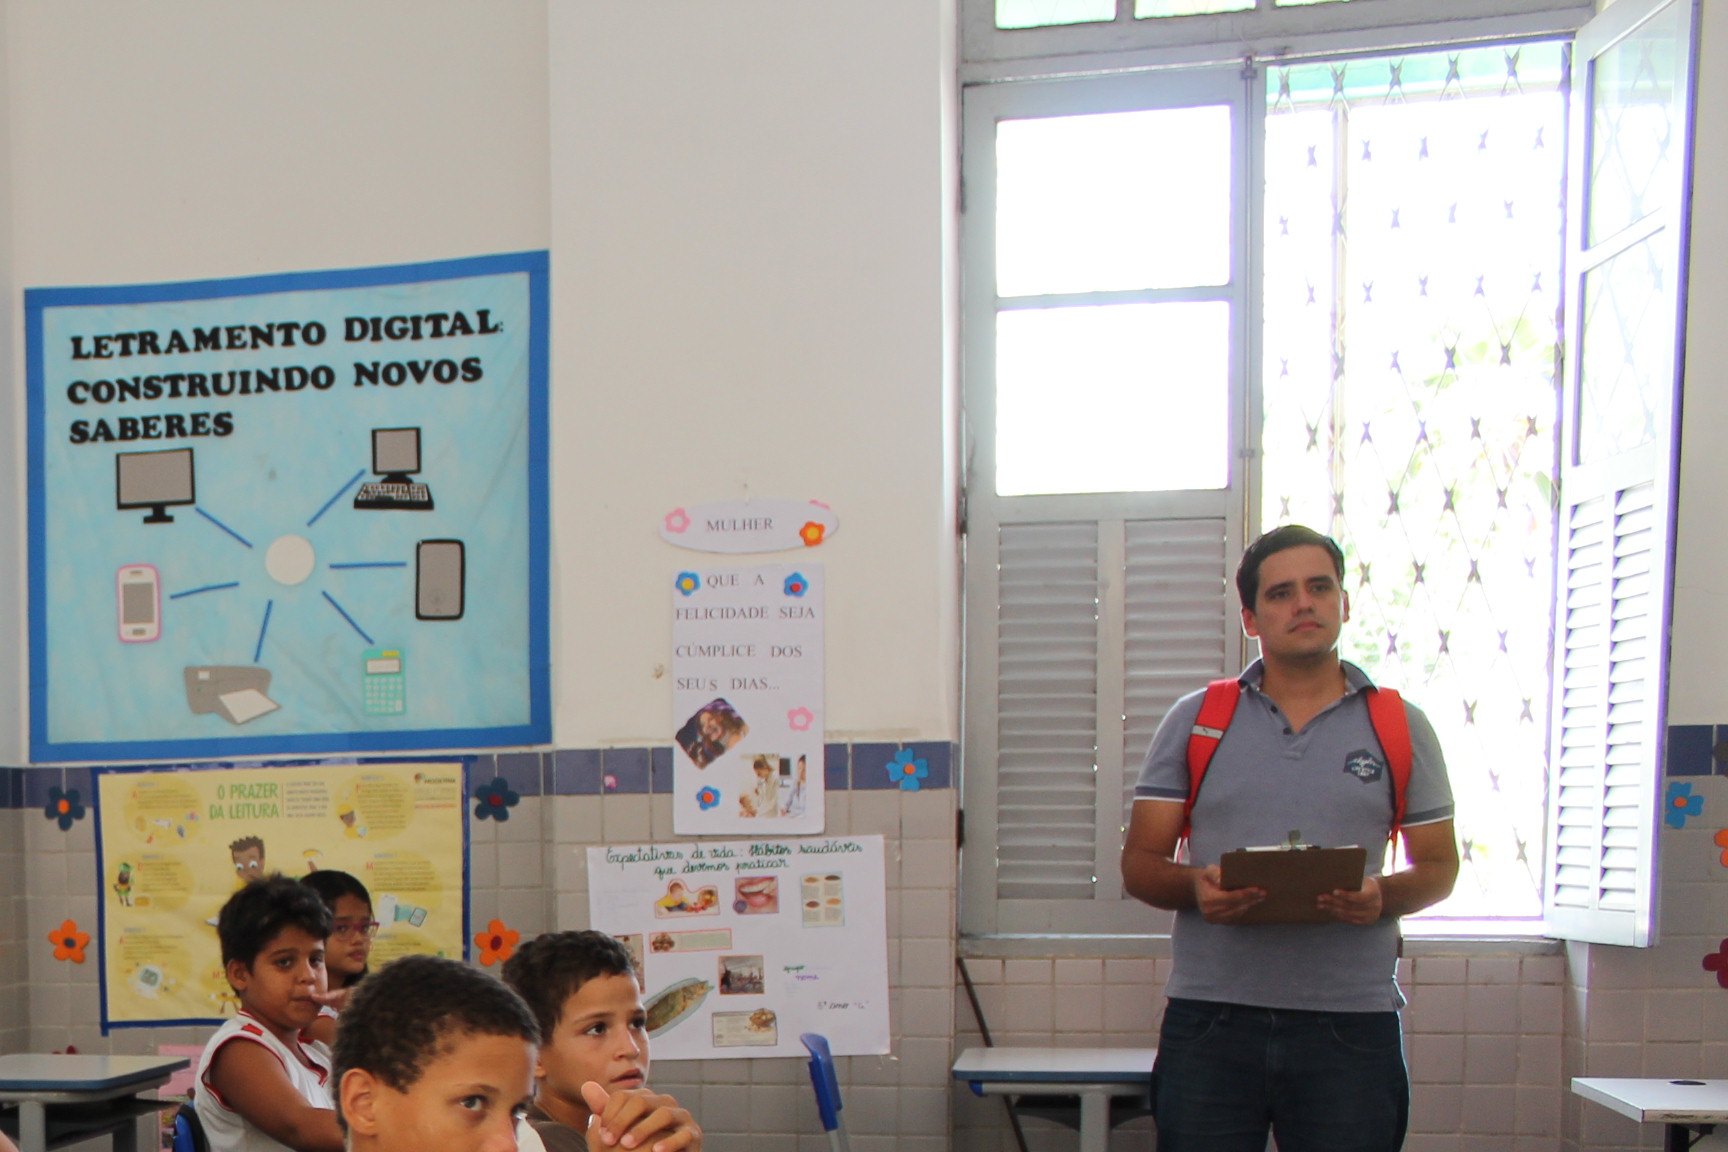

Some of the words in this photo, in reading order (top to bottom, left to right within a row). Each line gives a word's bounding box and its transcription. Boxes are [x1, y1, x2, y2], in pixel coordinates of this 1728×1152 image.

[70, 321, 327, 360] LETRAMENTO
[67, 365, 336, 404] CONSTRUINDO
[353, 356, 484, 388] NOVOS
[69, 411, 234, 444] SABERES
[706, 517, 773, 532] MULHER
[707, 574, 739, 589] QUE
[754, 574, 765, 586] A
[676, 606, 769, 620] FELICIDADE
[778, 606, 815, 619] SEJA
[676, 643, 756, 658] CÚMPLICE
[771, 645, 802, 658] DOS
[676, 677, 718, 691] SEUS
[731, 678, 780, 691] DIAS...
[217, 784, 225, 799] O
[230, 782, 279, 799] PRAZER
[209, 804, 225, 819] DA
[229, 802, 280, 819] LEITURA
[606, 844, 684, 871] Expectativas
[691, 843, 706, 859] de
[654, 864, 677, 880] que
[681, 860, 730, 874] devemos
[735, 858, 790, 875] praticar
